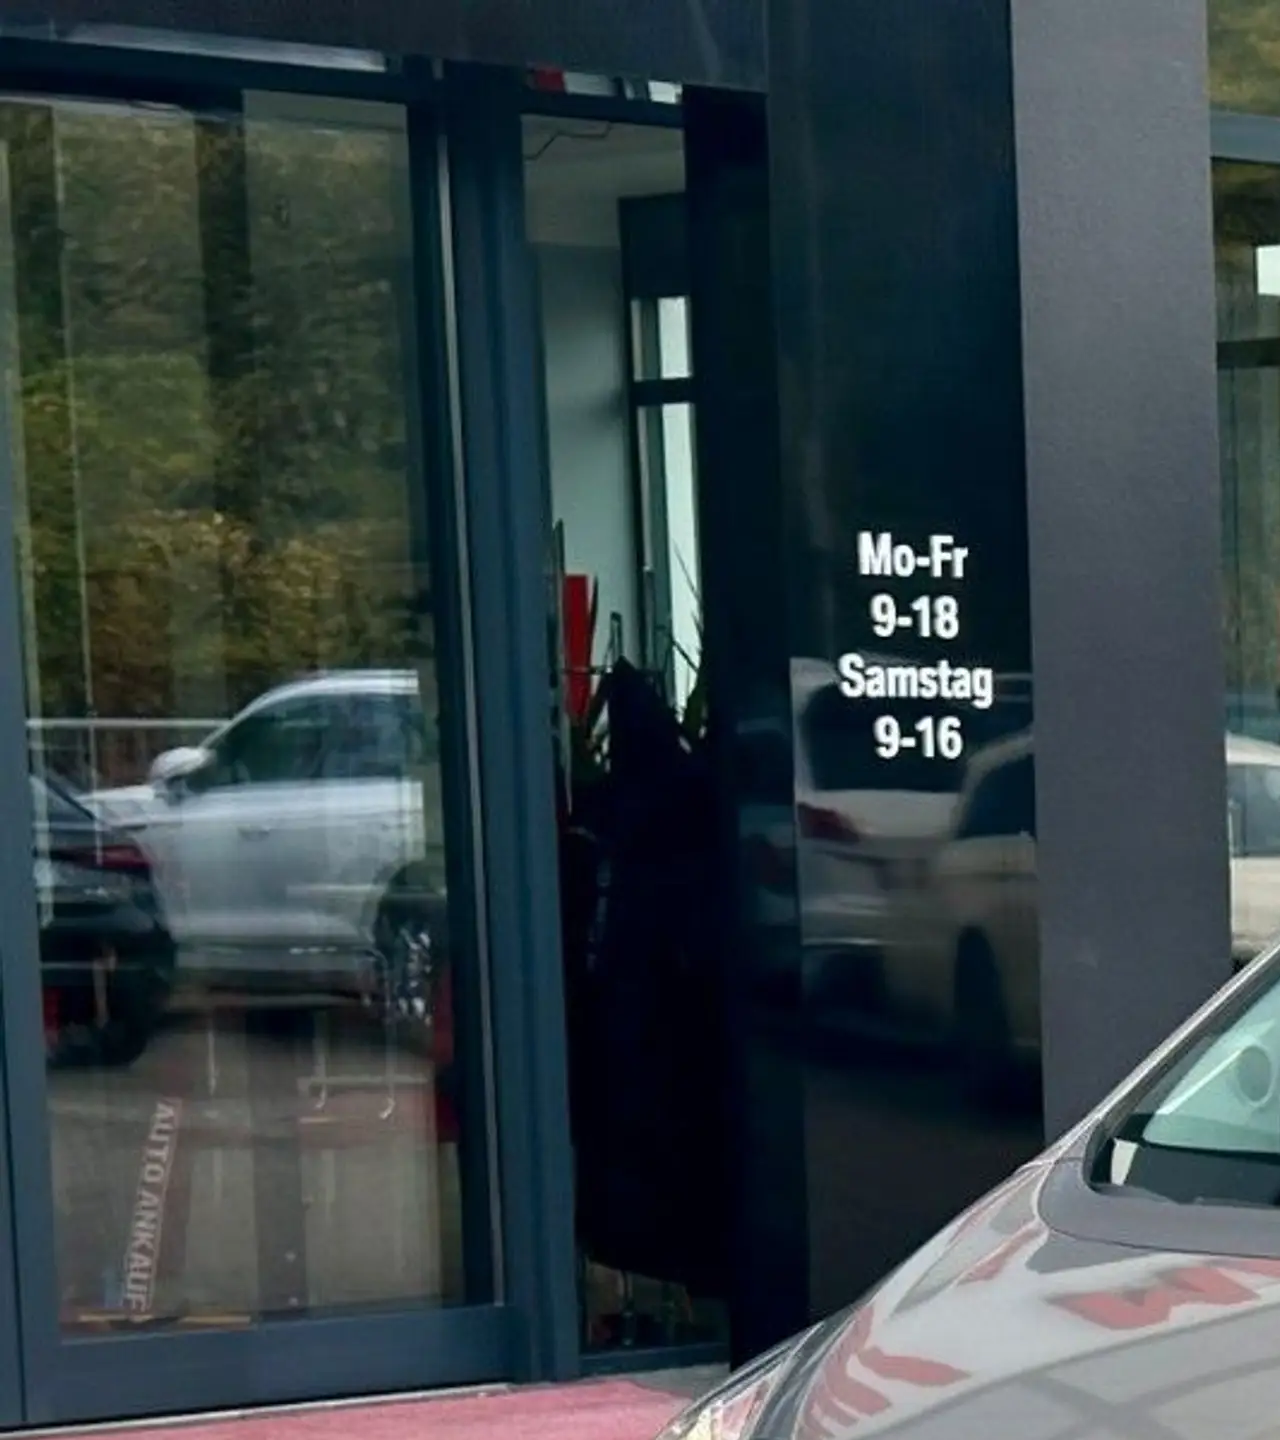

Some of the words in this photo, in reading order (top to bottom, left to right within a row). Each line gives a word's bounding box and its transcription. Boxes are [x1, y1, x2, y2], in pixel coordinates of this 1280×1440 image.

[857, 530, 969, 578] Mo-Fr
[870, 593, 960, 639] 9-18
[838, 652, 994, 709] Samstag
[873, 715, 964, 759] 9-16
[143, 1102, 175, 1183] AUTO
[126, 1189, 160, 1312] ANKAUF
